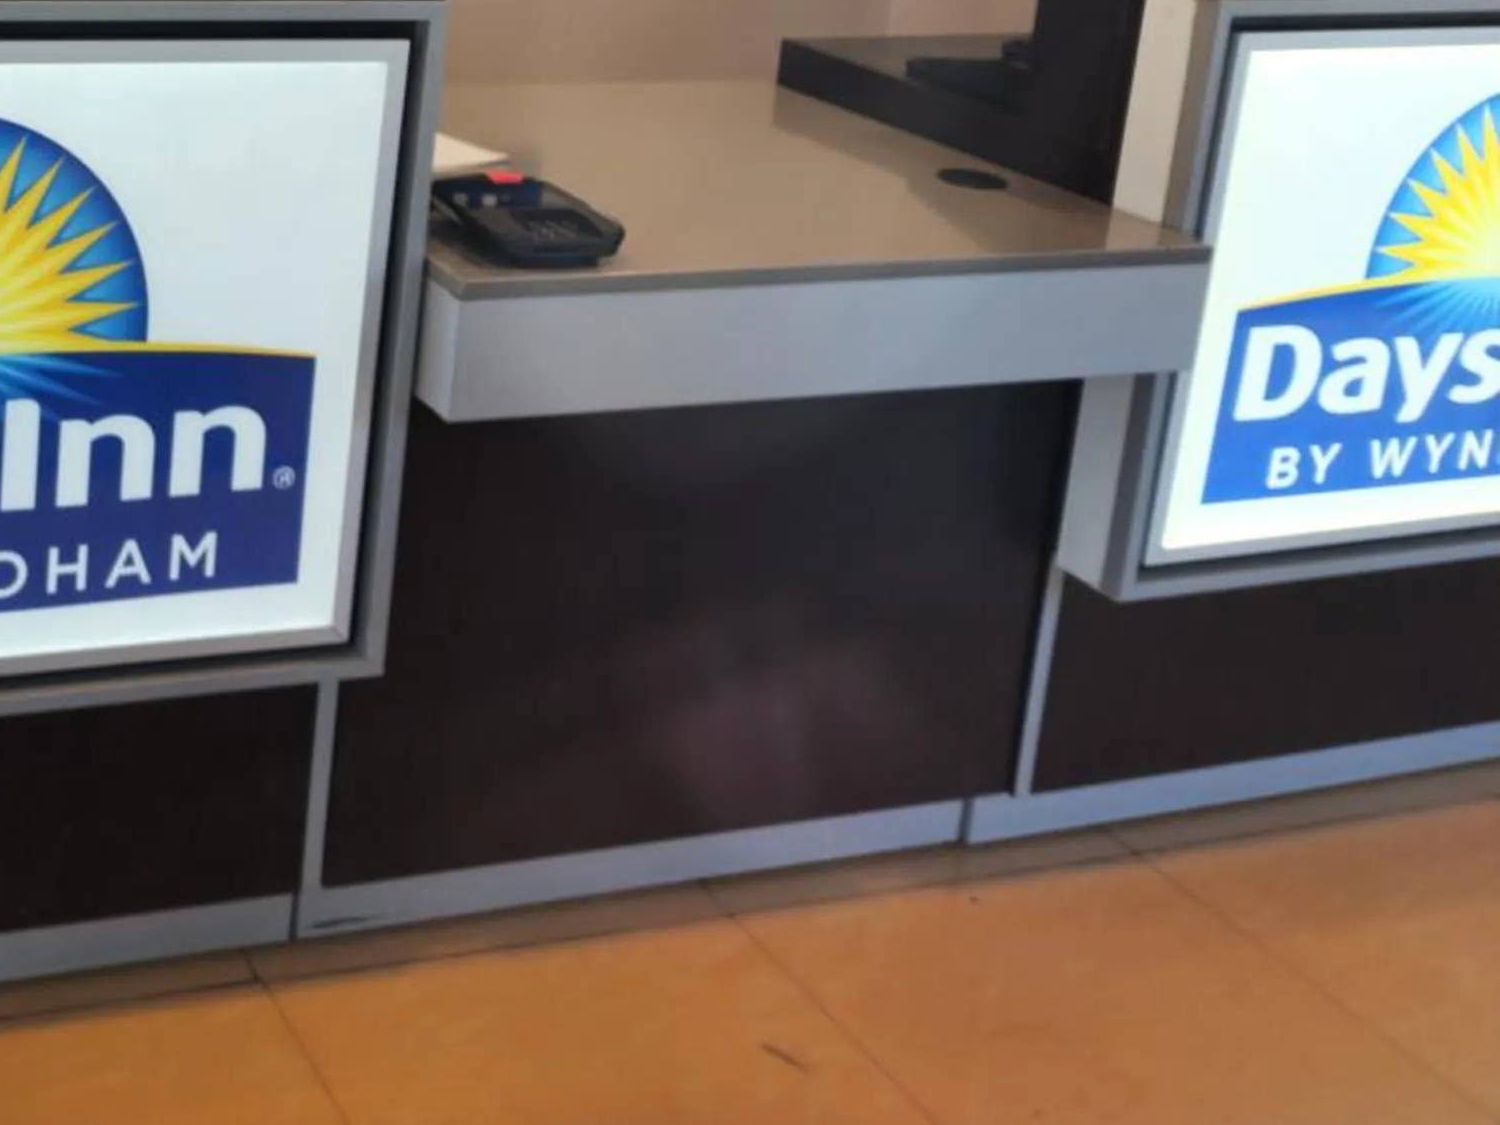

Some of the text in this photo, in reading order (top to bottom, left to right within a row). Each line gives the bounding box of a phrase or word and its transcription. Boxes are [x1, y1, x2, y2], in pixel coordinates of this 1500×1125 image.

[1232, 325, 1500, 424] Days
[0, 398, 269, 513] Inn
[1265, 429, 1500, 490] BY WYN
